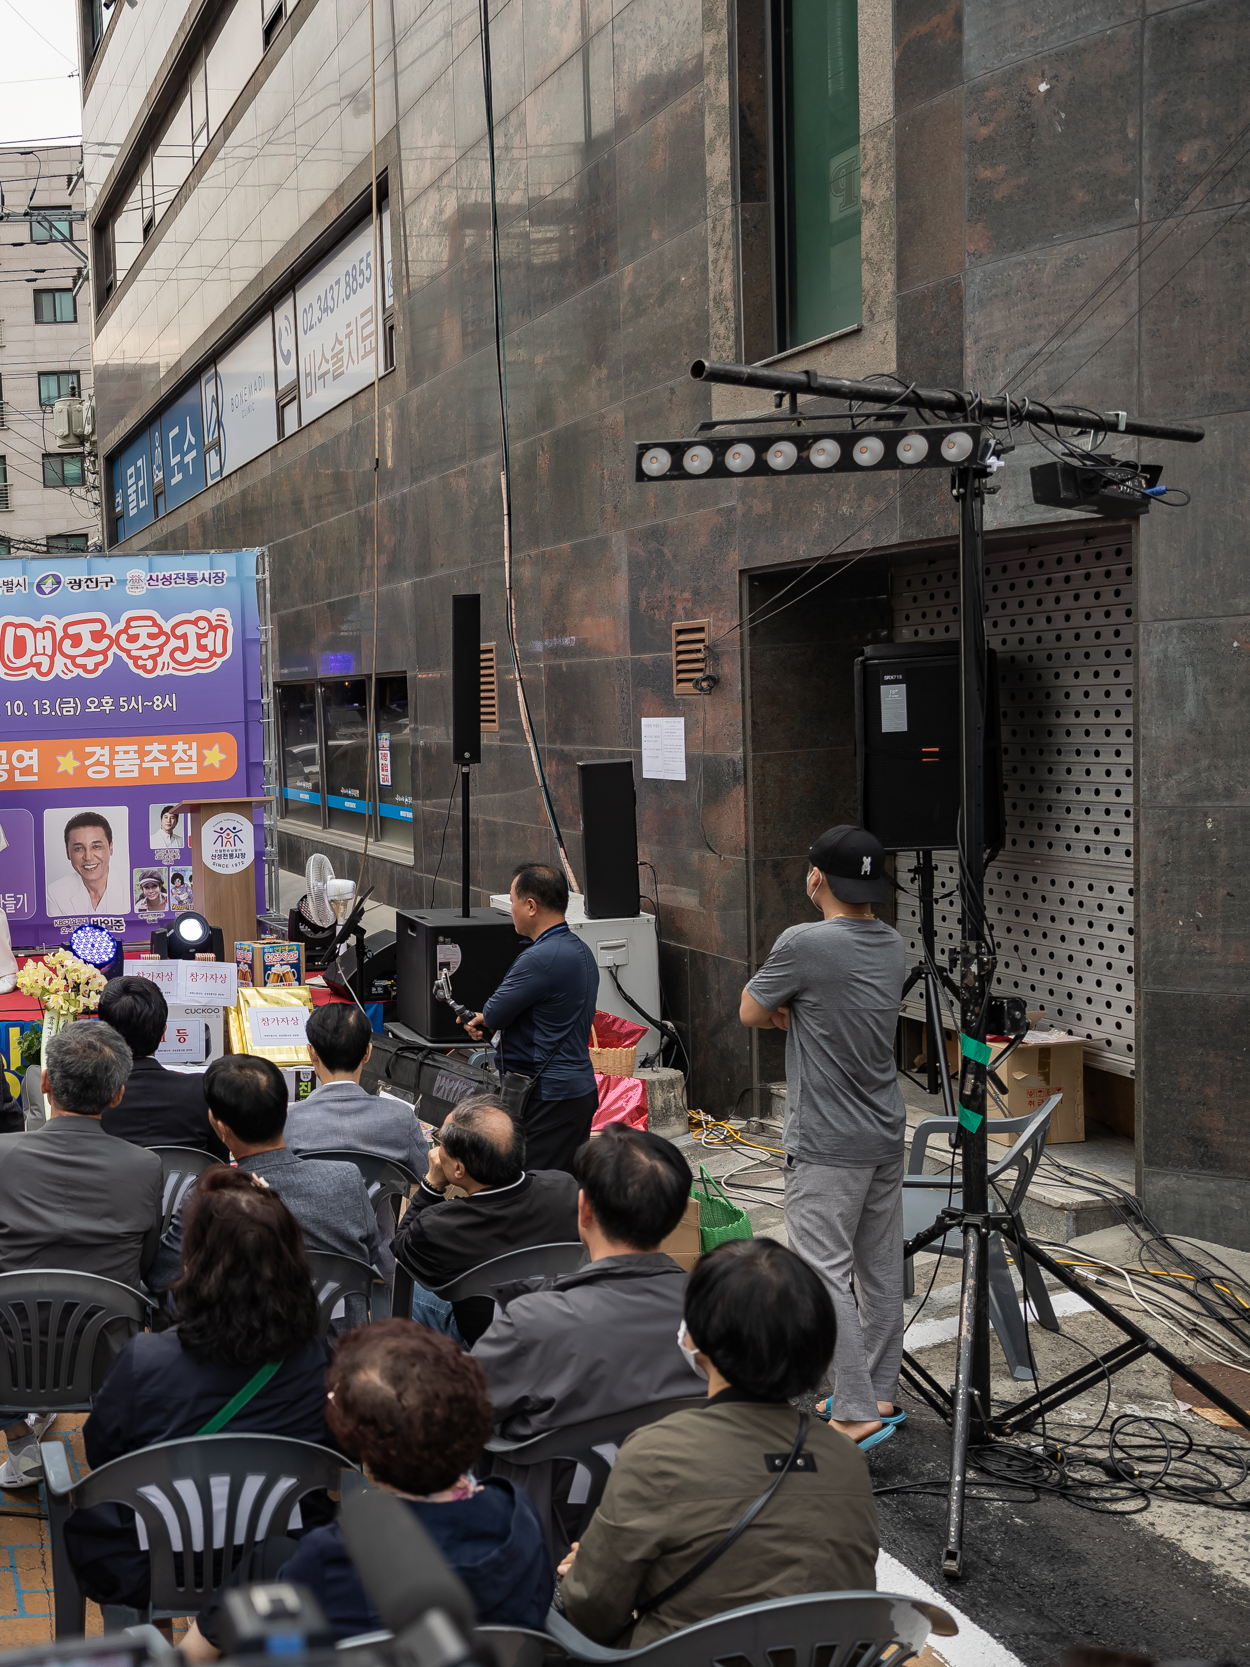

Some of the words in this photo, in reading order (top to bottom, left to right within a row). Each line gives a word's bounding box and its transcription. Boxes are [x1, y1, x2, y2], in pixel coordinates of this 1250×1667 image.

[302, 251, 373, 336] 02.3437.8855
[304, 304, 377, 400] 비수술치료
[230, 373, 266, 413] BONEMADI
[241, 402, 256, 419] CLINIC
[127, 454, 149, 518] 물리
[168, 416, 197, 486] 도수
[66, 575, 116, 591] 광진구
[146, 571, 226, 587] 신성전통시장
[5, 700, 28, 718] 10.
[32, 697, 81, 718] 13.(금)
[85, 697, 116, 714] 오후
[119, 693, 177, 715] 5시~8시
[83, 741, 198, 778] 경품추첨
[189, 971, 228, 984] 참가자상
[261, 1016, 300, 1027] 참가자상
[175, 1028, 189, 1044] 등
[299, 1081, 312, 1096] 진
